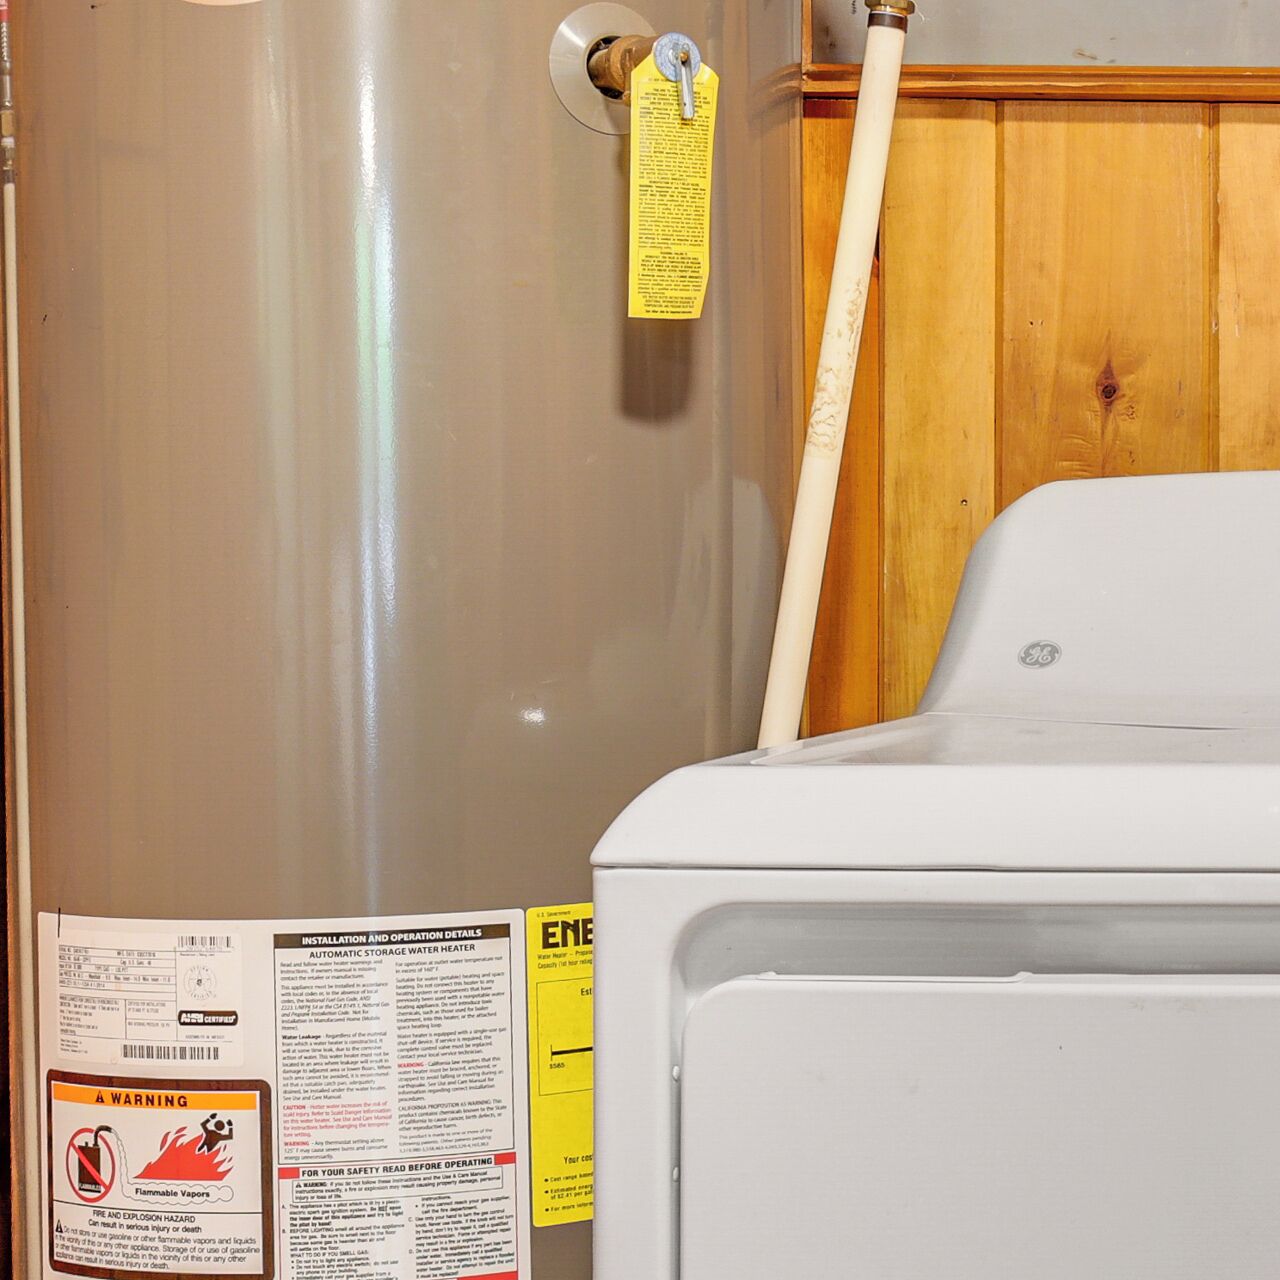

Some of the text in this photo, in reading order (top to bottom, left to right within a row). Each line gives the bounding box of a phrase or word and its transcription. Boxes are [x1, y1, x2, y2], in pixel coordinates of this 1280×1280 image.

[302, 929, 482, 945] INSTALLATION AND OPERATION DETAILS
[309, 944, 476, 958] AUTOMATIC STORAGE WATER HEATER
[111, 1092, 189, 1108] WARNING
[301, 1157, 493, 1177] FOR YOUR SAFETY READ BEFORE OPERATING
[134, 1188, 210, 1199] Flammable Vapors
[93, 1210, 105, 1218] FIRE
[123, 1212, 162, 1222] EXPLOSION
[164, 1215, 196, 1223] HAZARD
[88, 1219, 99, 1227] Can
[126, 1223, 149, 1231] serious
[151, 1224, 170, 1233] injury
[158, 1236, 191, 1244] flammable
[233, 1237, 256, 1245] liquids
